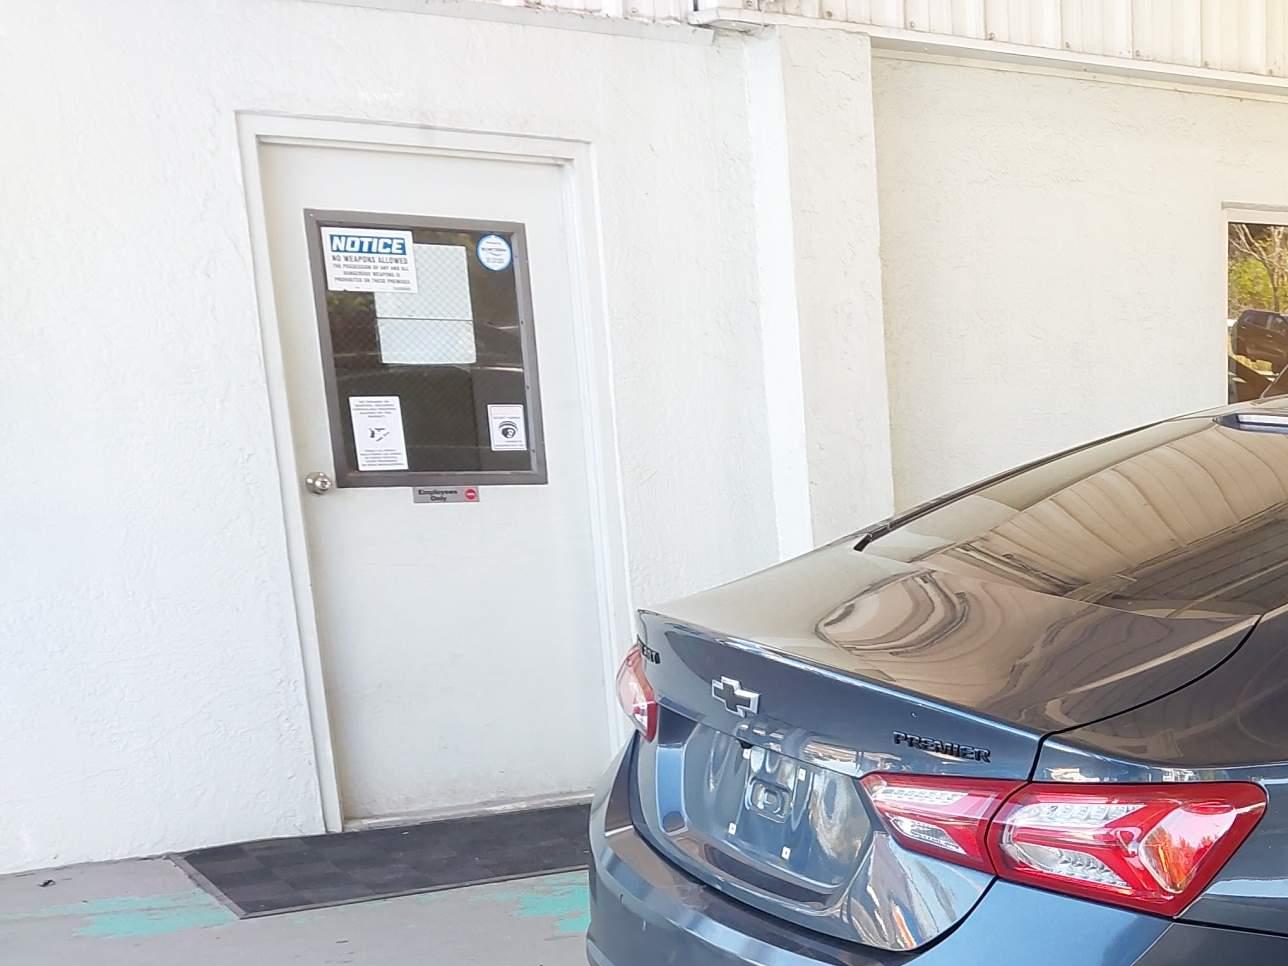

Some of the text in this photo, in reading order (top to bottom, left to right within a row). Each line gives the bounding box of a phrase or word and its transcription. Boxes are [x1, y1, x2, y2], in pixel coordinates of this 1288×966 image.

[331, 236, 405, 254] NOTICE
[343, 255, 376, 264] WEAPONS
[378, 257, 408, 265] ALLOWED
[892, 730, 991, 763] PREMIER
